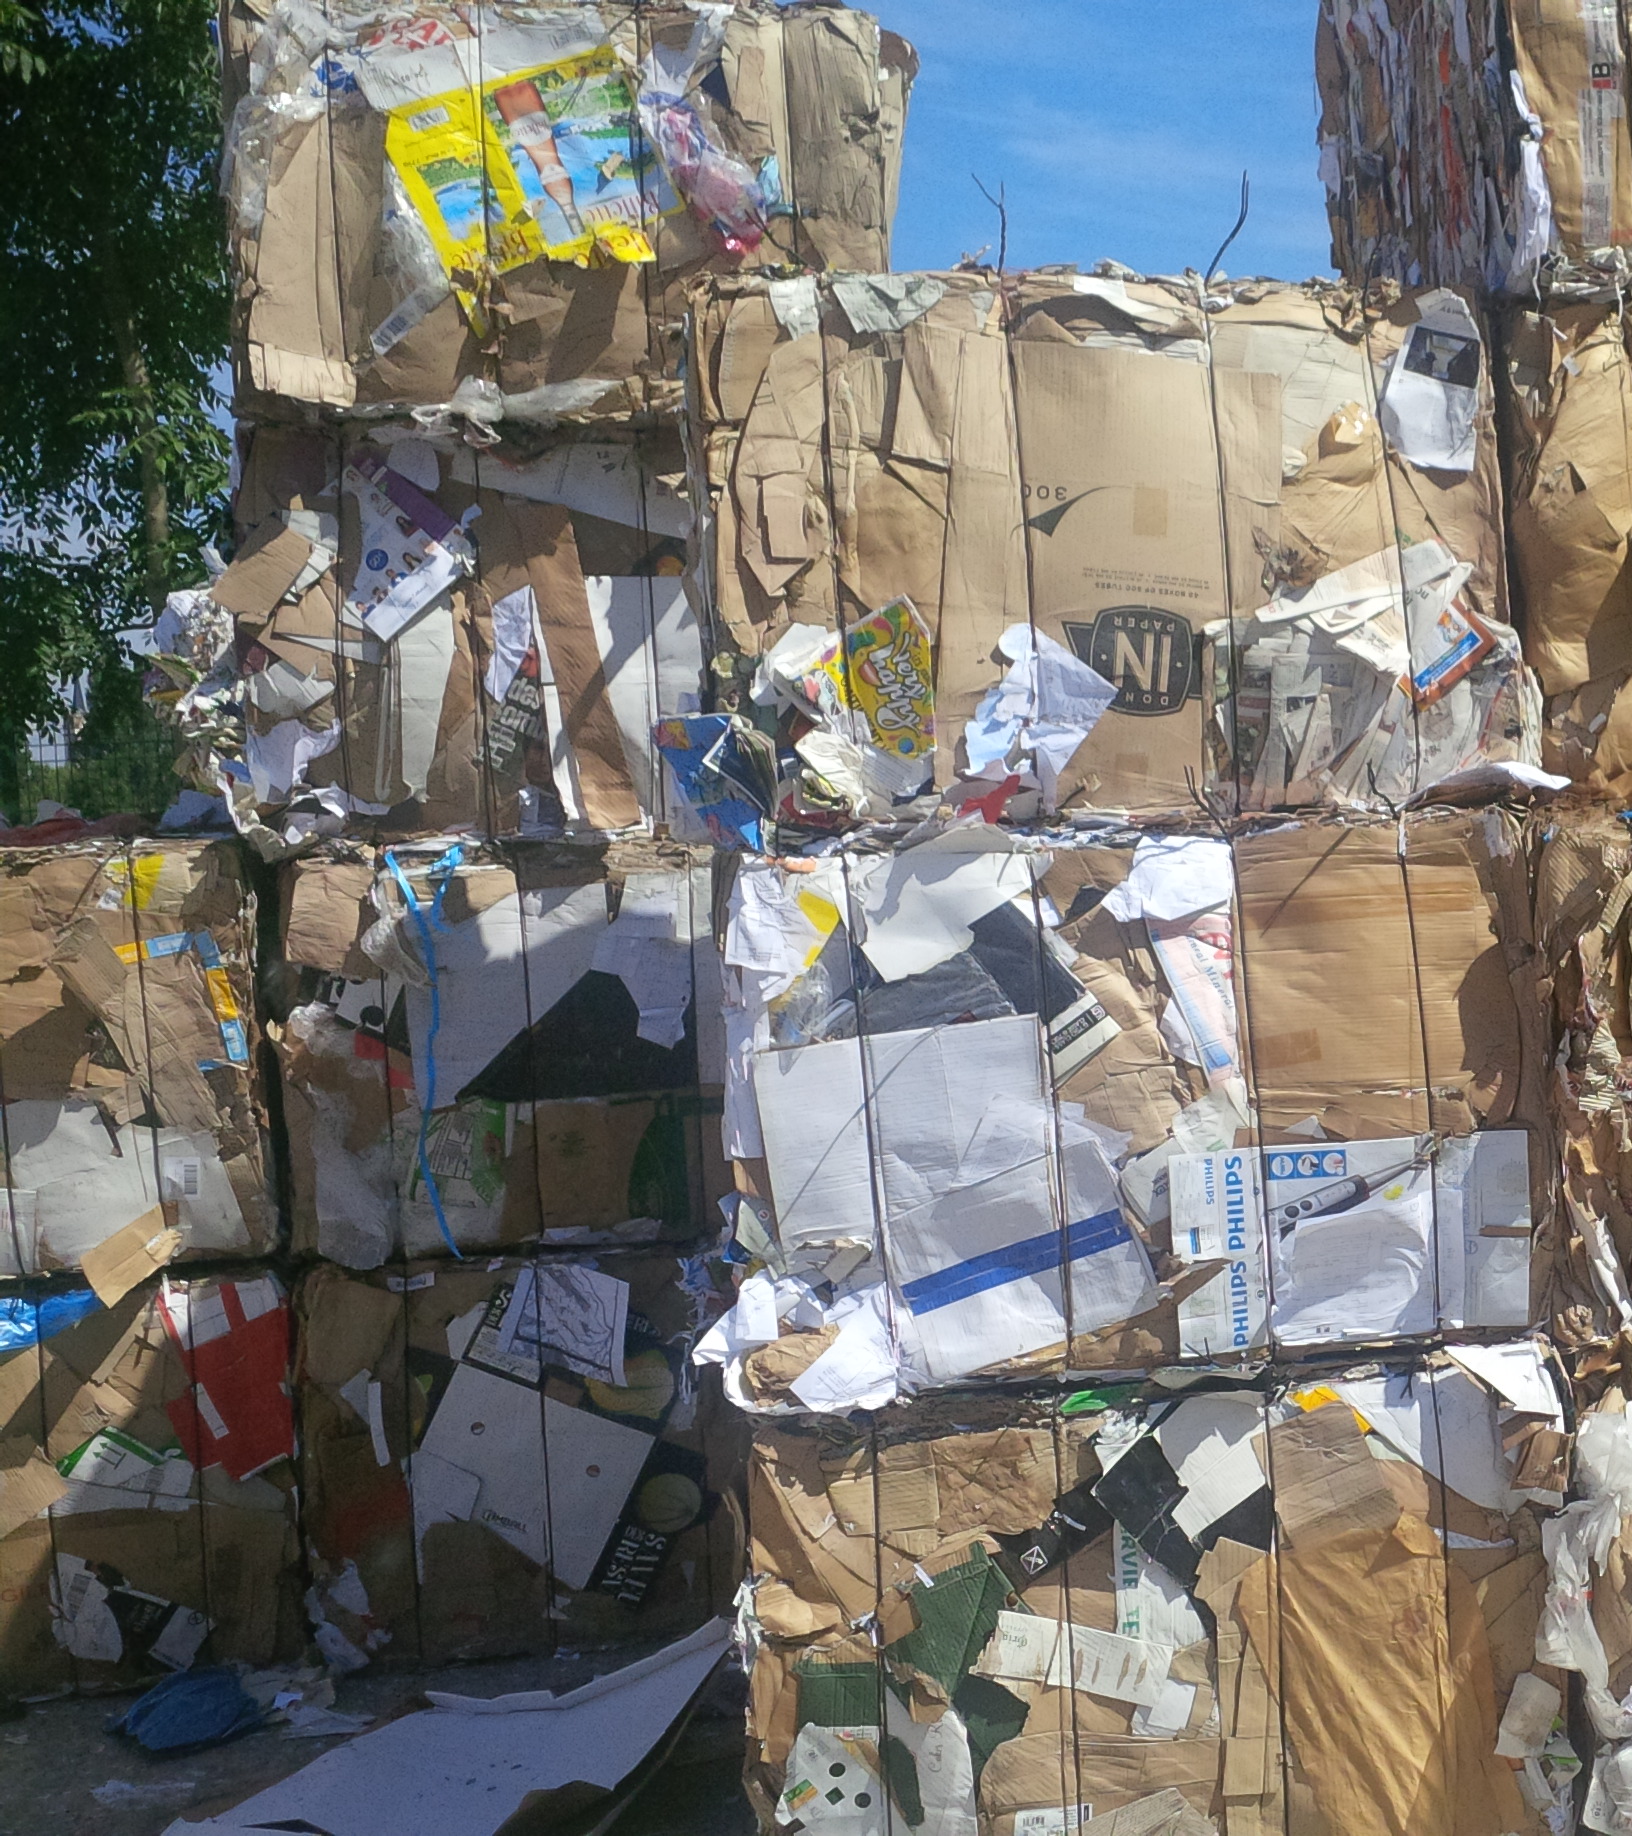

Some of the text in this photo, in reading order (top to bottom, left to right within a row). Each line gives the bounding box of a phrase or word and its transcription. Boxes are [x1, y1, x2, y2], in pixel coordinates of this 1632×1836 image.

[1112, 616, 1176, 632] PAPER
[1113, 631, 1172, 693] IN
[1124, 692, 1169, 706] DON
[1204, 1158, 1215, 1205] PHILIPS
[1225, 1155, 1246, 1251] PHILIPS
[1230, 1260, 1249, 1347] PHILIPS
